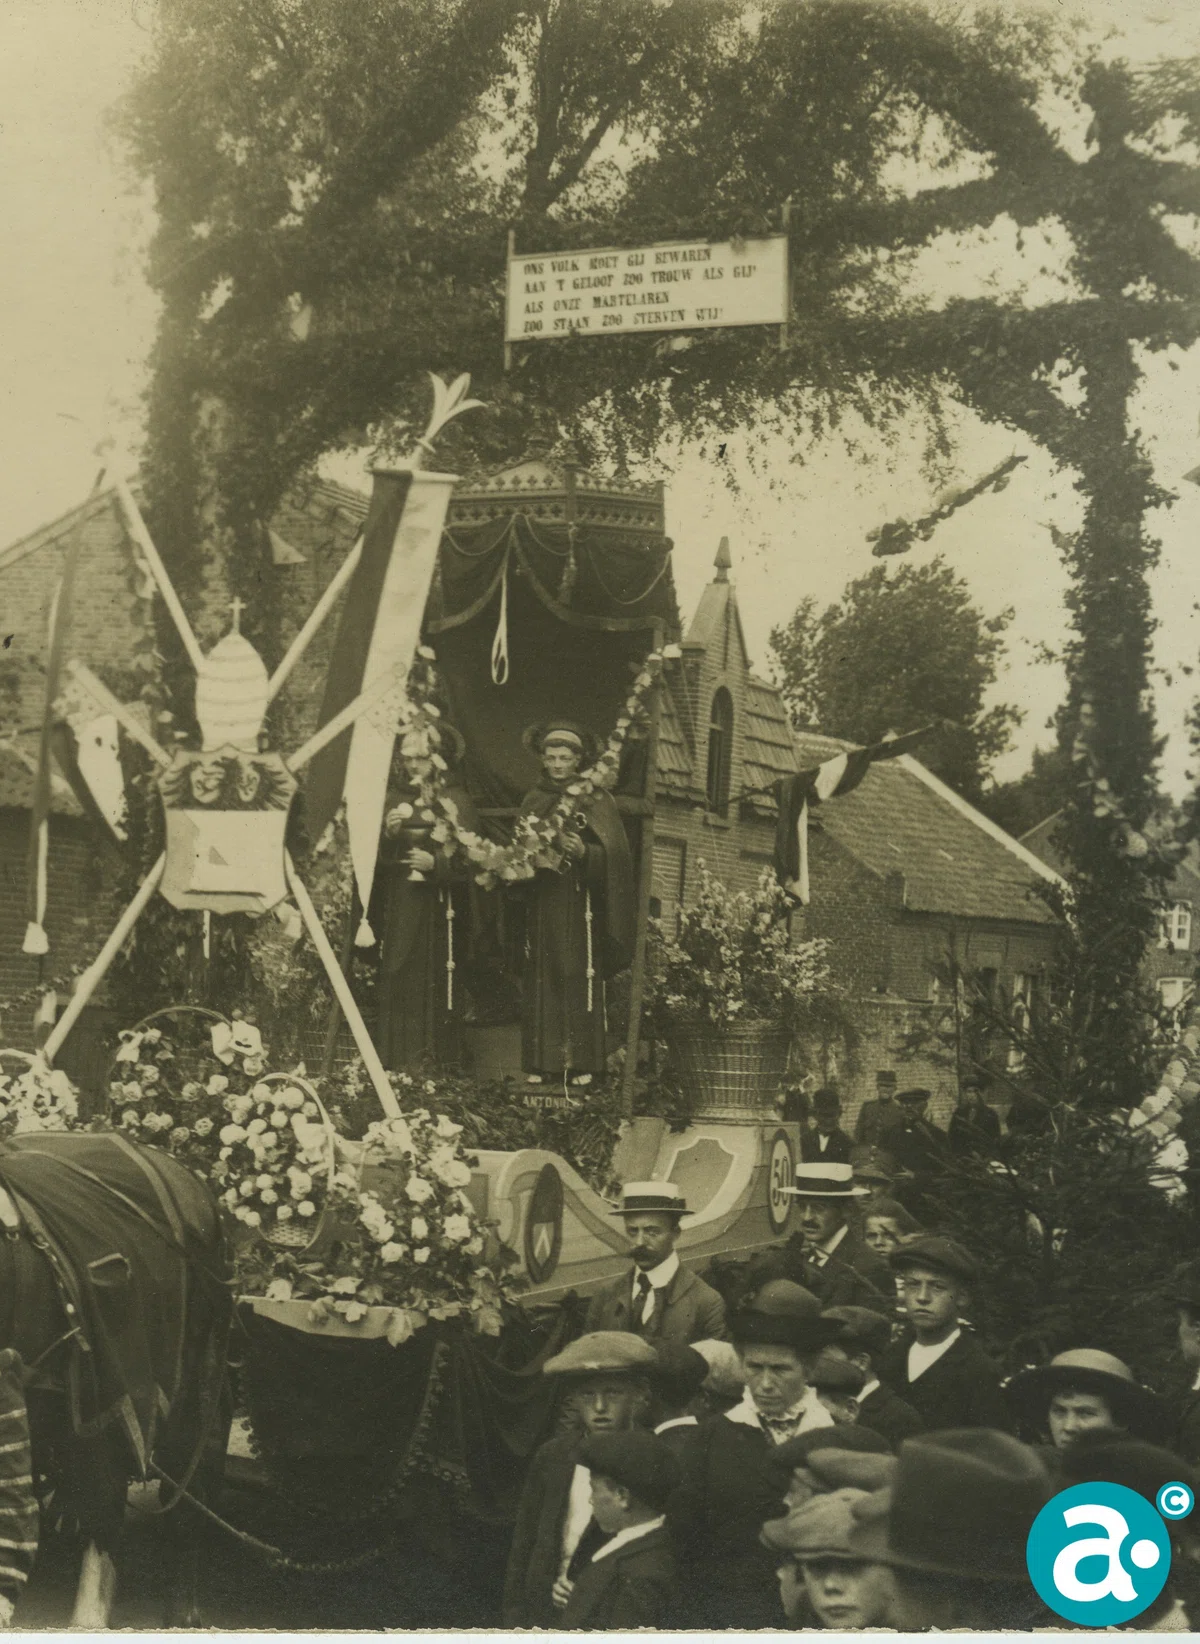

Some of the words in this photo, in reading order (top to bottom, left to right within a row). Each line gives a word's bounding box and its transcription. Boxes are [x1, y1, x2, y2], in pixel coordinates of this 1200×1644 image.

[524, 262, 544, 275] ONS
[551, 260, 579, 273] VOLK
[627, 253, 645, 267] GIJ
[655, 248, 712, 265] BEWAREN
[524, 281, 546, 294] AAN
[573, 275, 614, 290] GELOOF
[623, 272, 643, 286] ZOO
[651, 268, 693, 284] TROUW
[703, 267, 724, 280] ALS
[524, 301, 544, 314] ALS
[553, 298, 581, 311] ONZE
[593, 291, 670, 308] MARTELAREN
[524, 320, 543, 333] ZOO
[553, 316, 590, 330] STAAN
[602, 314, 623, 327] ZOO
[634, 309, 685, 325] STERVEN
[522, 1095, 583, 1109] ANTONIU
